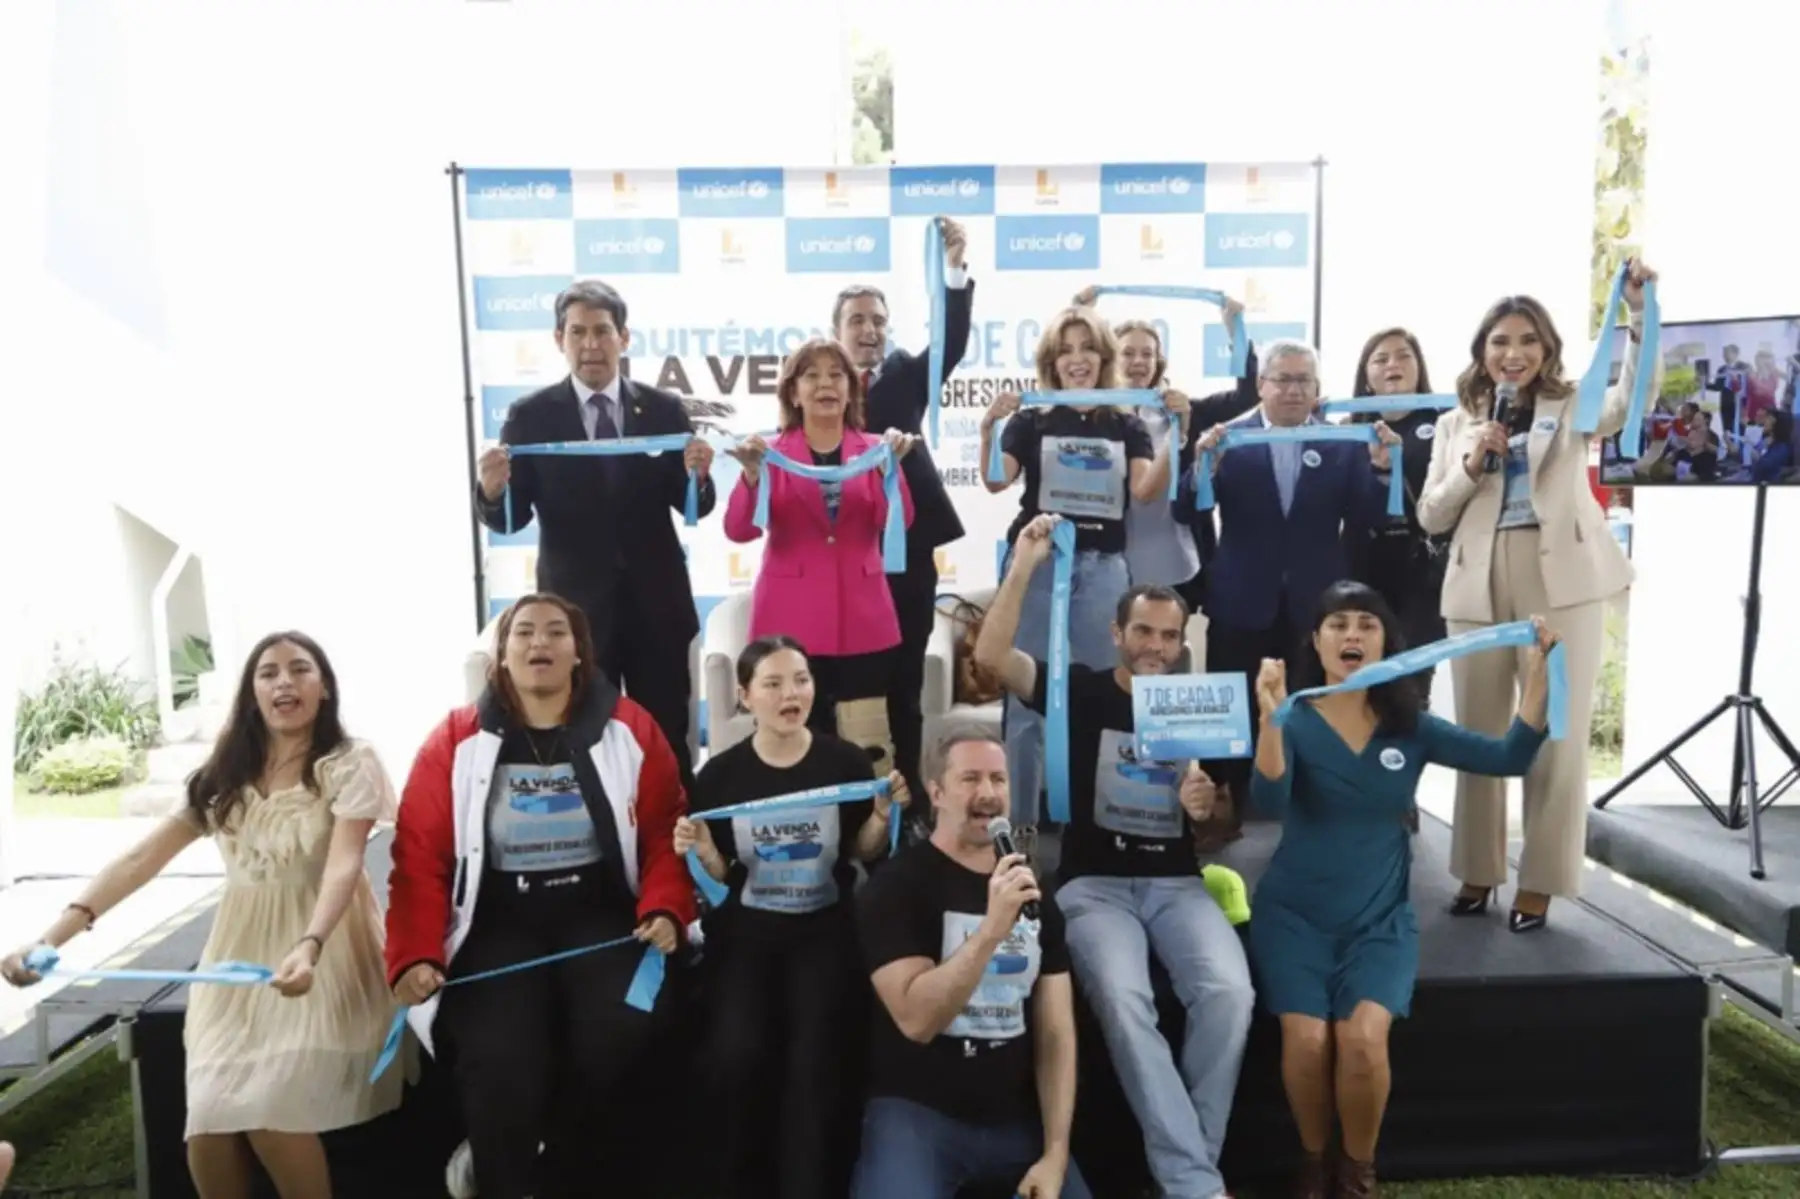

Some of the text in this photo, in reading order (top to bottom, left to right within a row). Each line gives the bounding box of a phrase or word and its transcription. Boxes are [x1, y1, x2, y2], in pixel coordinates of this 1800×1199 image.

[692, 180, 746, 199] unicef
[904, 178, 956, 197] unicef
[1114, 176, 1167, 195] unicef
[588, 235, 643, 255] unicef
[800, 234, 854, 254] unicef
[1009, 231, 1063, 251] unicef
[1218, 231, 1273, 250] unicef
[1143, 688, 1152, 706] 7
[1154, 687, 1172, 705] DE
[1177, 685, 1216, 705] CADA
[751, 821, 821, 838] LA VENDA
